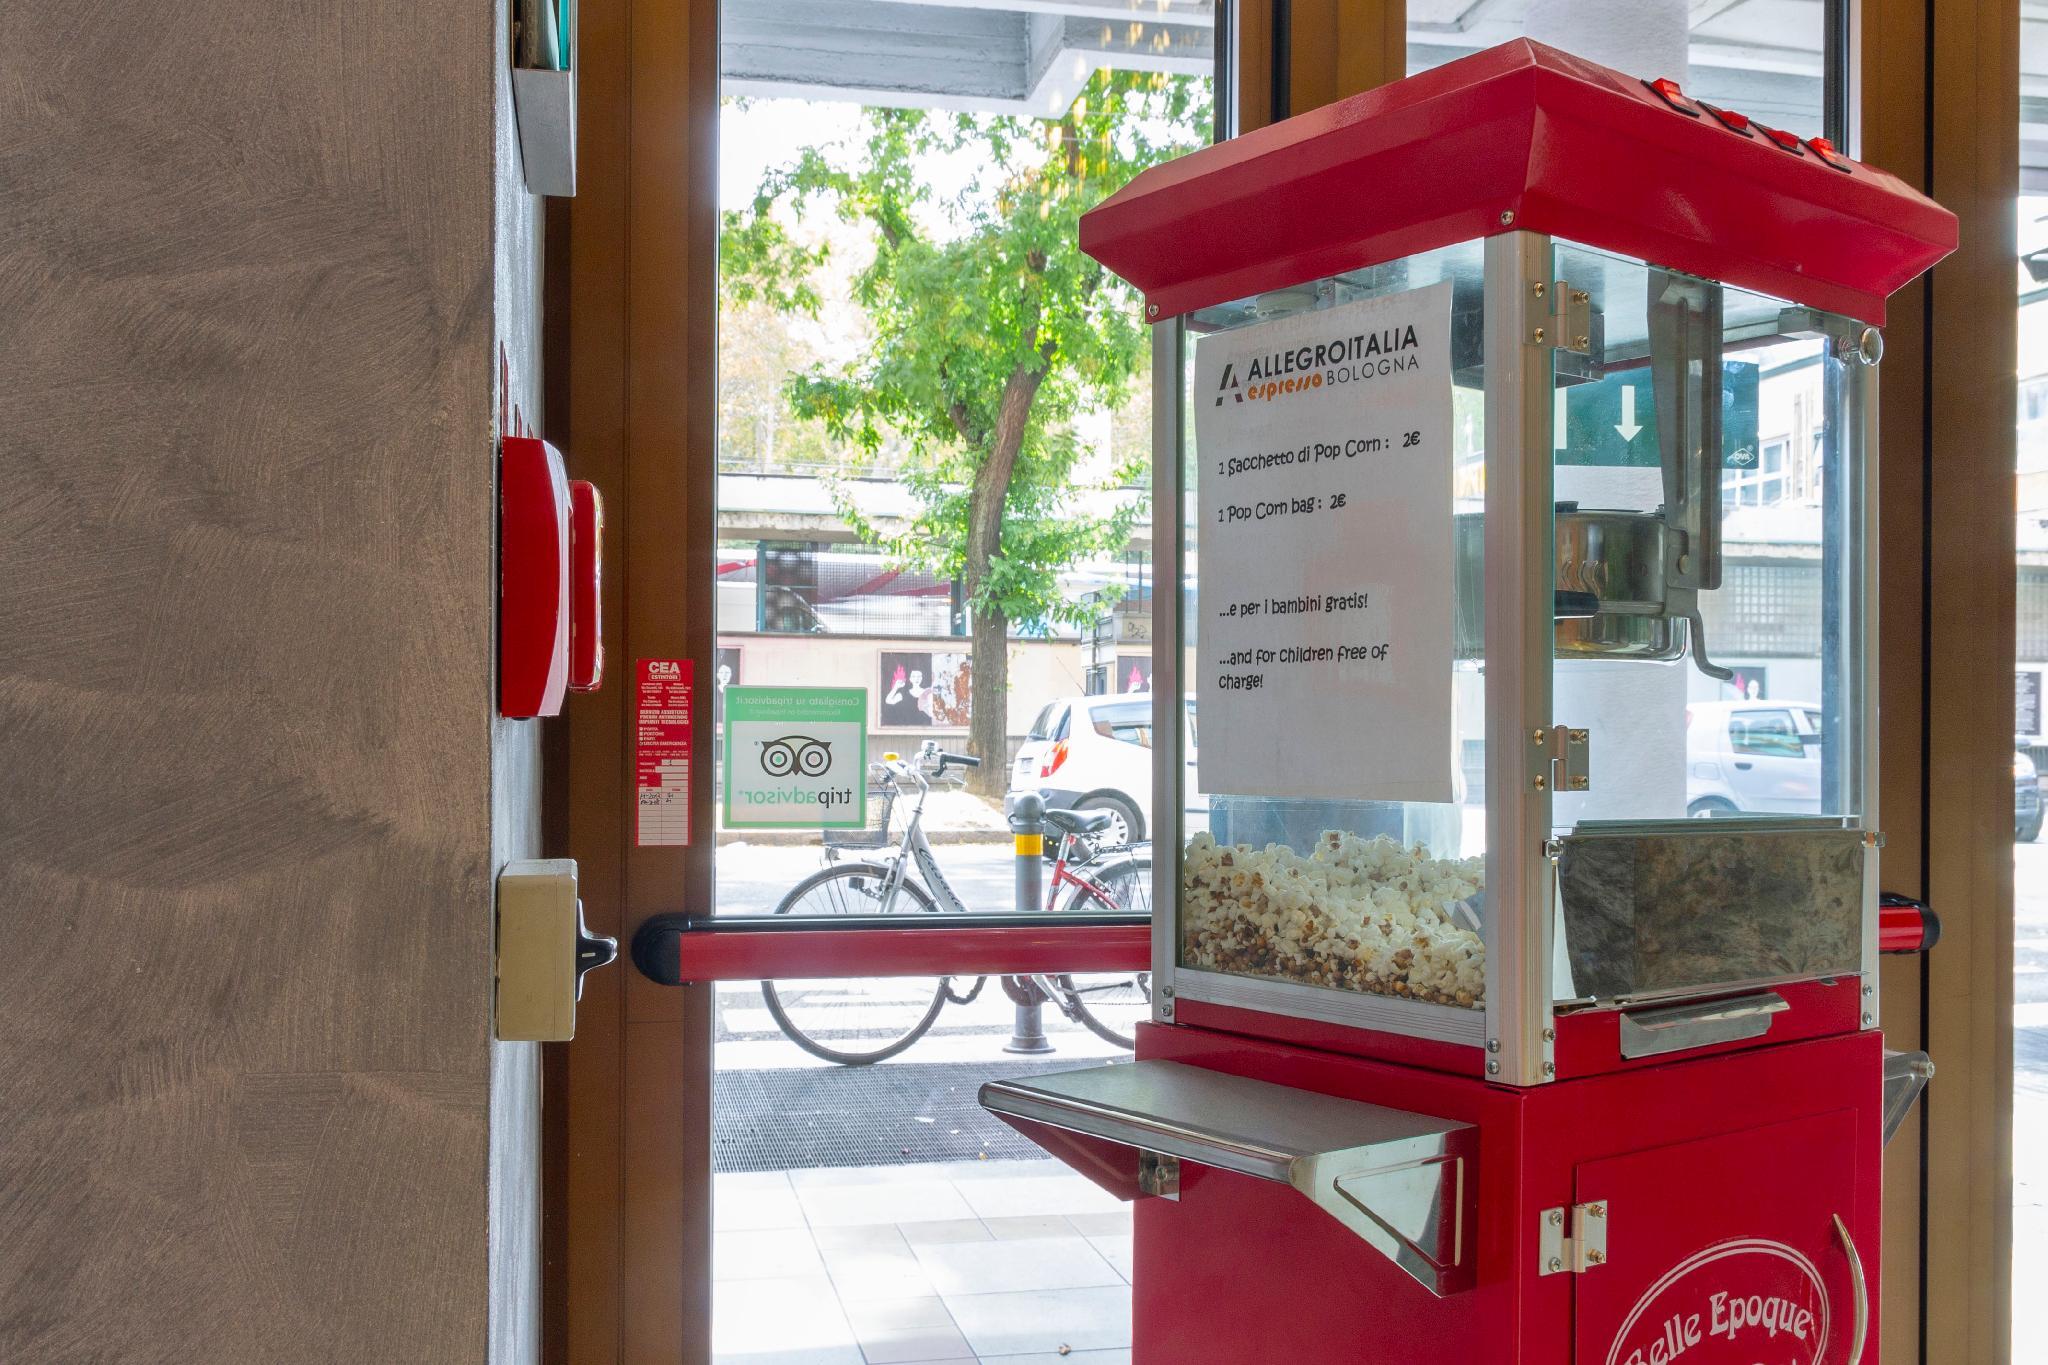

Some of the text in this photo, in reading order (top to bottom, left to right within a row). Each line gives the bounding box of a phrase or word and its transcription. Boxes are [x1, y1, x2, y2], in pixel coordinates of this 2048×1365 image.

[1248, 325, 1419, 381] ALLEGROITALIA
[1247, 354, 1419, 401] espresso BOLOGNA
[1218, 462, 1225, 475] 1
[1228, 449, 1294, 477] Sacchetto
[1297, 445, 1310, 463] di
[1314, 442, 1341, 463] Pop
[1345, 436, 1381, 458] Corn
[1402, 431, 1421, 448] 2€
[1218, 508, 1225, 522] 1
[1228, 504, 1251, 523] Pop
[1255, 502, 1287, 520] Corn
[1291, 497, 1315, 514] bag
[1329, 493, 1347, 509] 2€
[1240, 599, 1261, 618] per
[1271, 595, 1321, 614] bambini
[1325, 593, 1368, 613] gratis!
[648, 661, 680, 673] CEA
[1219, 649, 1251, 665] ...and
[1256, 648, 1276, 666] for
[1337, 645, 1367, 662] free
[1371, 643, 1389, 661] of
[1218, 673, 1264, 690] charge!
[1709, 1291, 1811, 1340] Epoque
